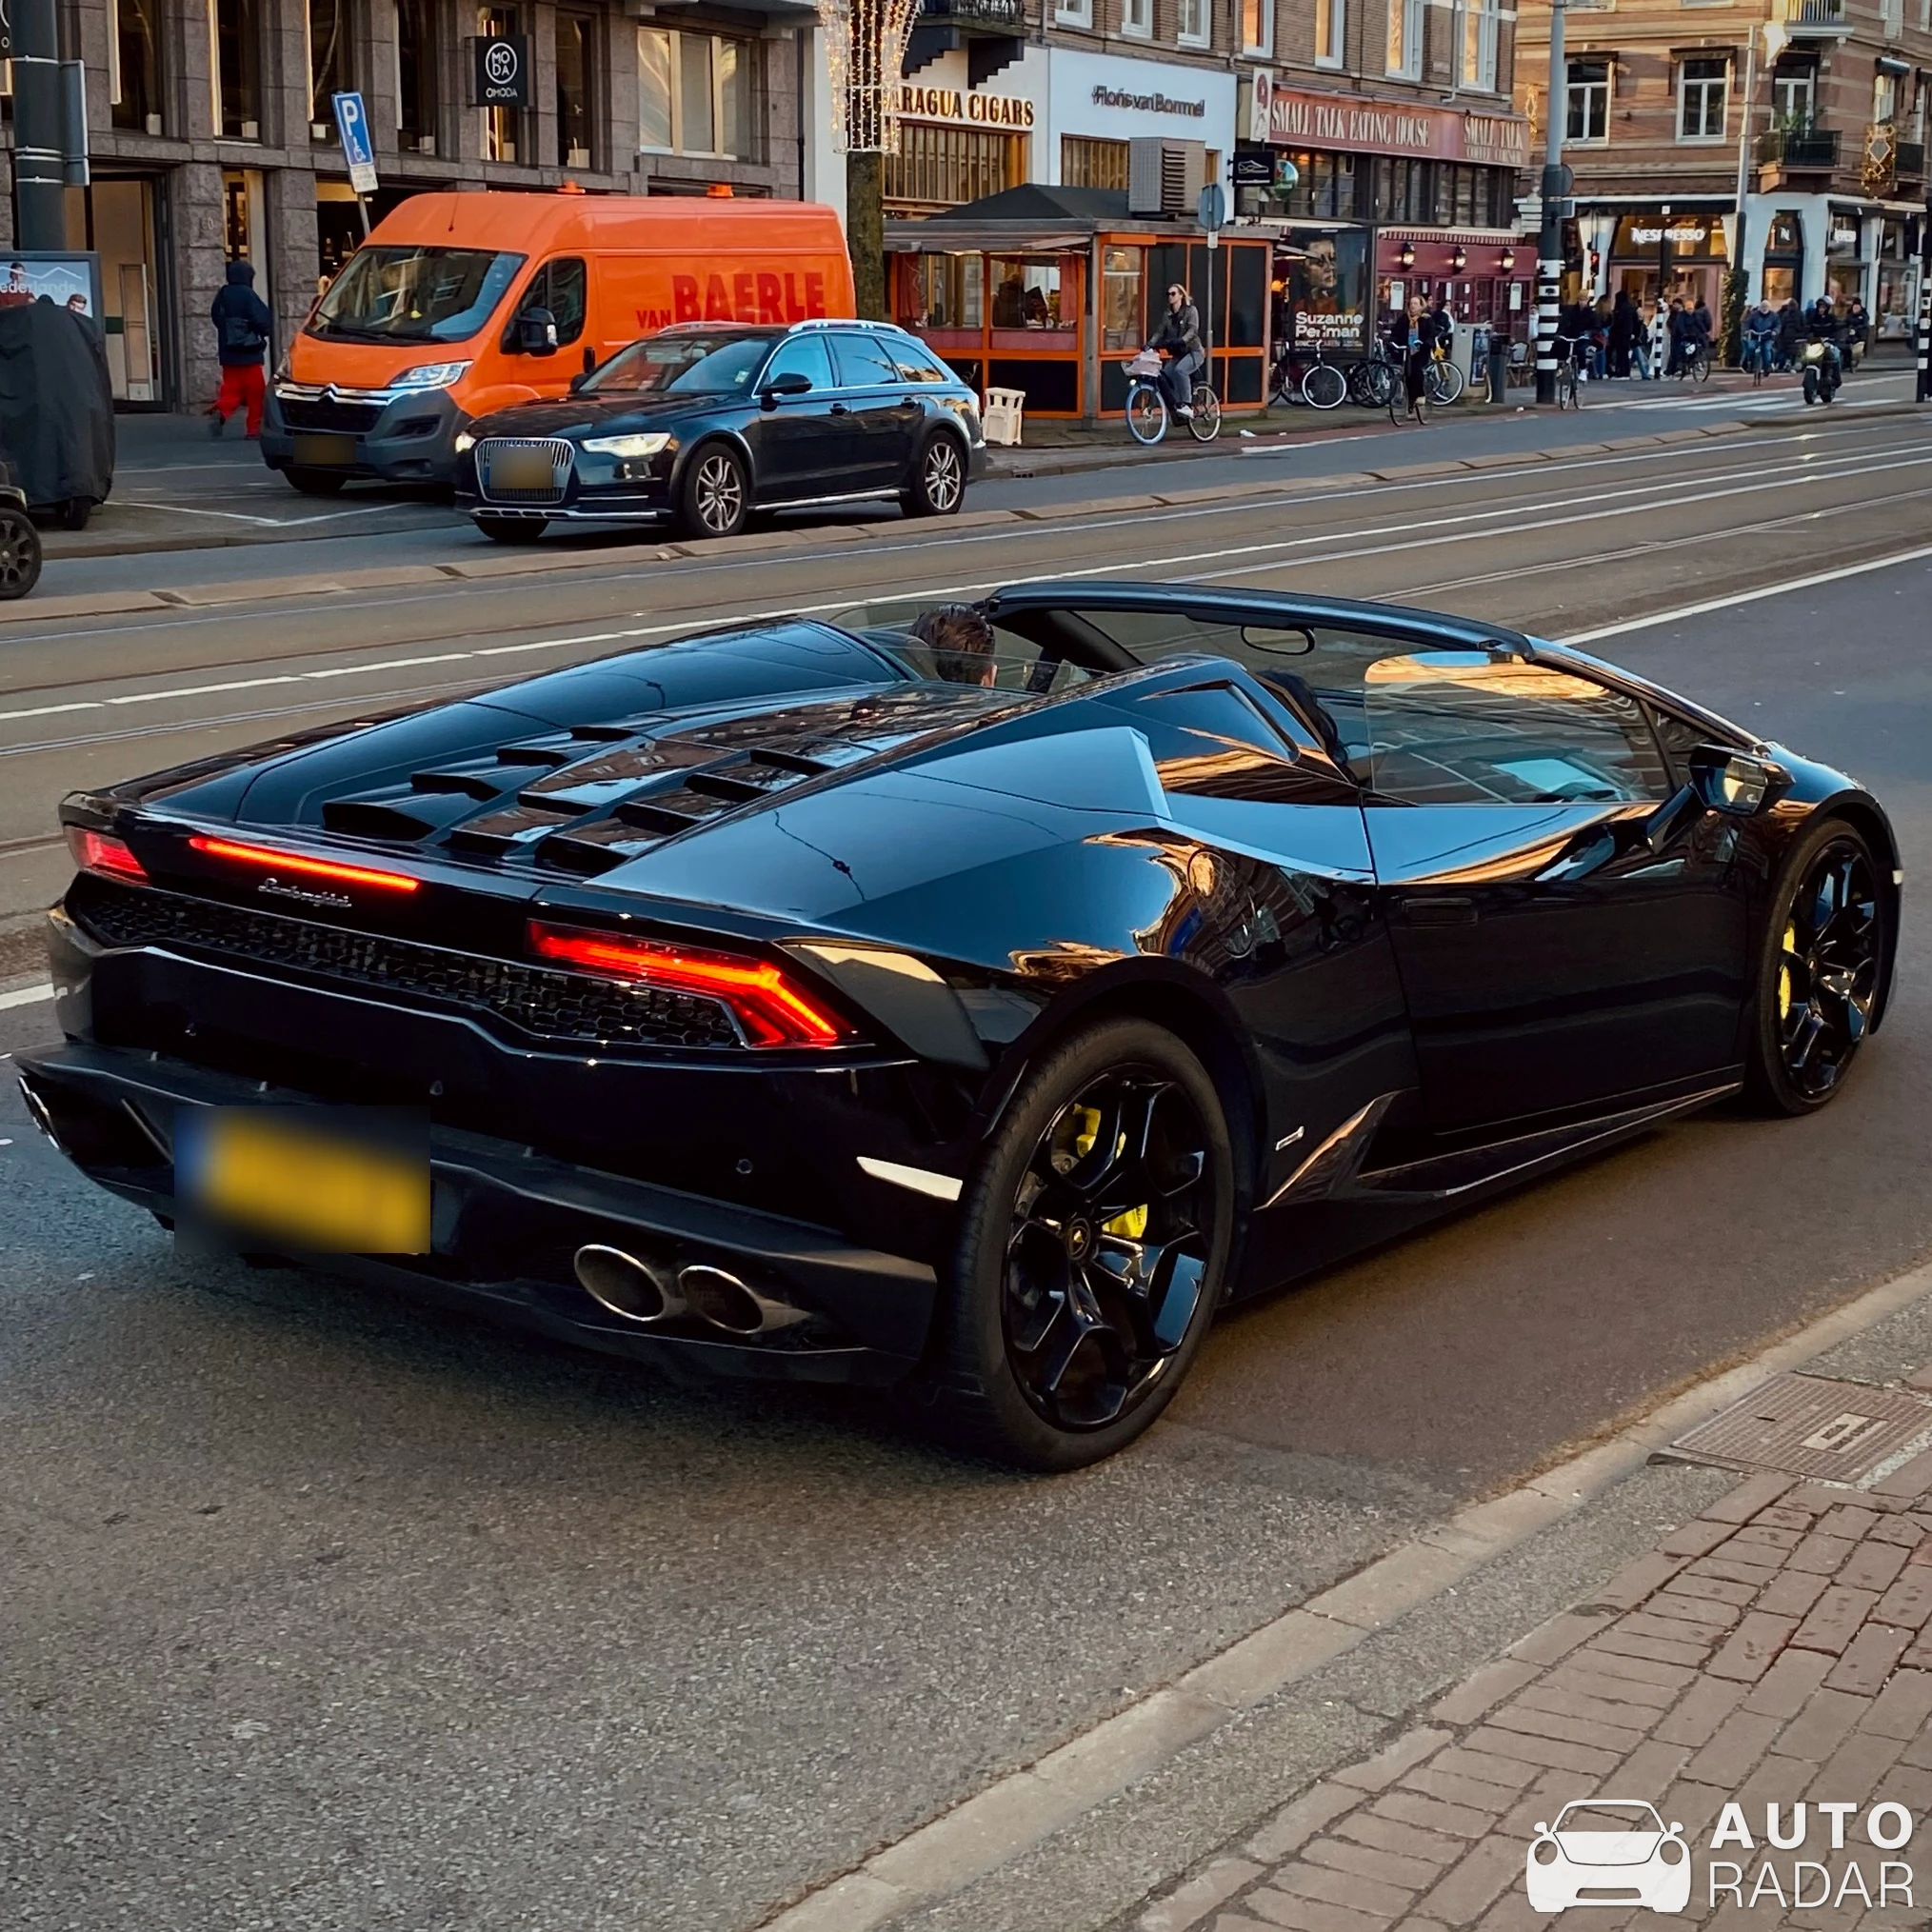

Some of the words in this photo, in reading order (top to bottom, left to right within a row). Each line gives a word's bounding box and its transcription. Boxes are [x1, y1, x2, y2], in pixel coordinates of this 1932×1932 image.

[486, 88, 518, 98] OMODA
[967, 93, 1034, 127] CIGARS
[341, 99, 359, 136] P
[1271, 99, 1311, 136] SMALL
[1314, 106, 1345, 140] TALK
[1349, 110, 1392, 145] EATING
[1396, 115, 1430, 148] HOUSE
[636, 309, 671, 329] VAN
[672, 272, 827, 324] BAERLE
[1295, 311, 1364, 326] Suzanne
